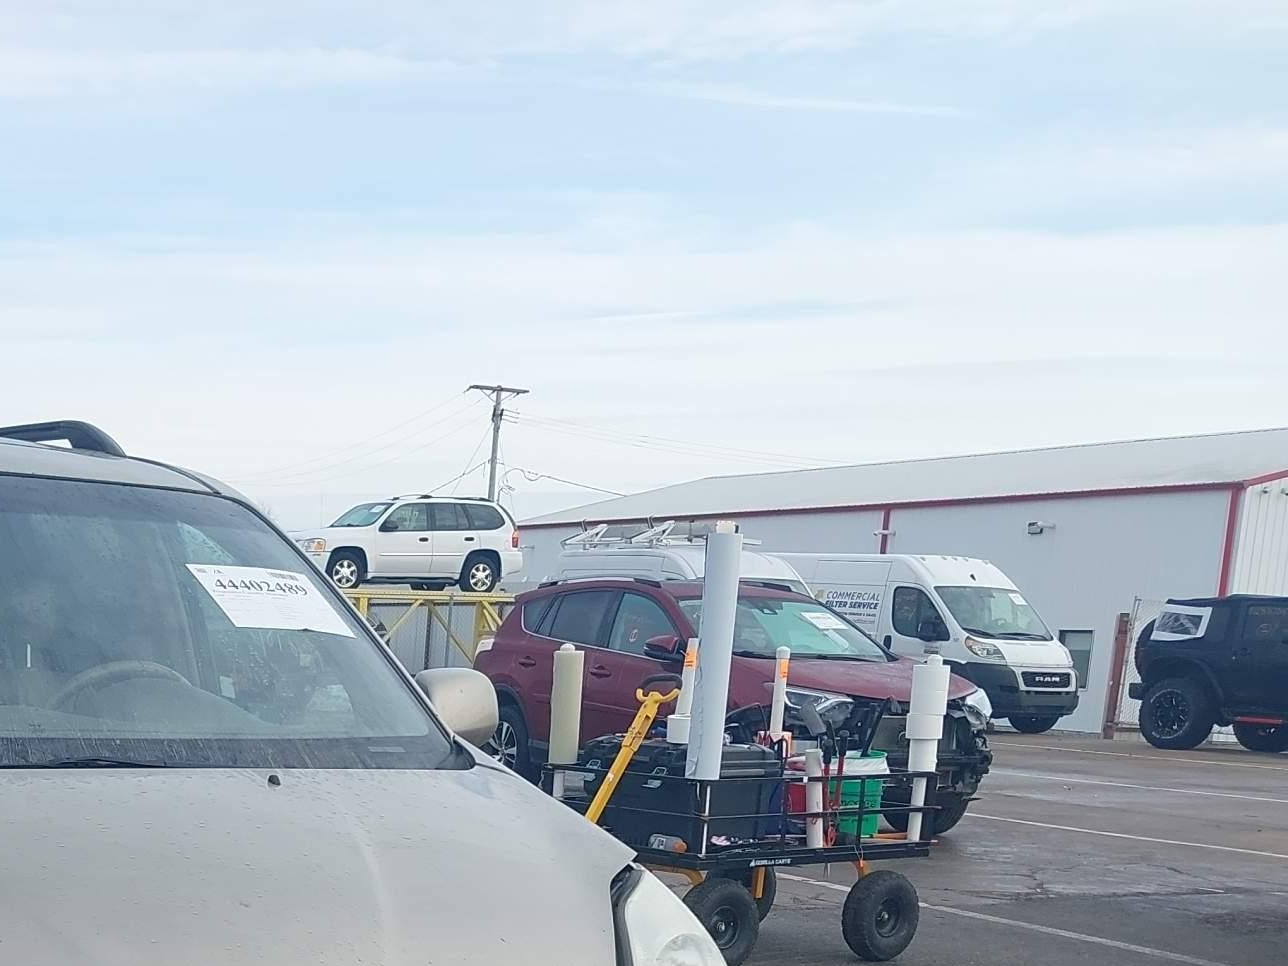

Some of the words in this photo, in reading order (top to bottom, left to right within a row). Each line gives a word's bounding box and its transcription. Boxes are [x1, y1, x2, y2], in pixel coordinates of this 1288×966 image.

[214, 578, 308, 596] 44402489
[826, 590, 880, 602] COMMERCIAL
[824, 599, 848, 609] FILTER
[848, 600, 880, 610] SERVICE
